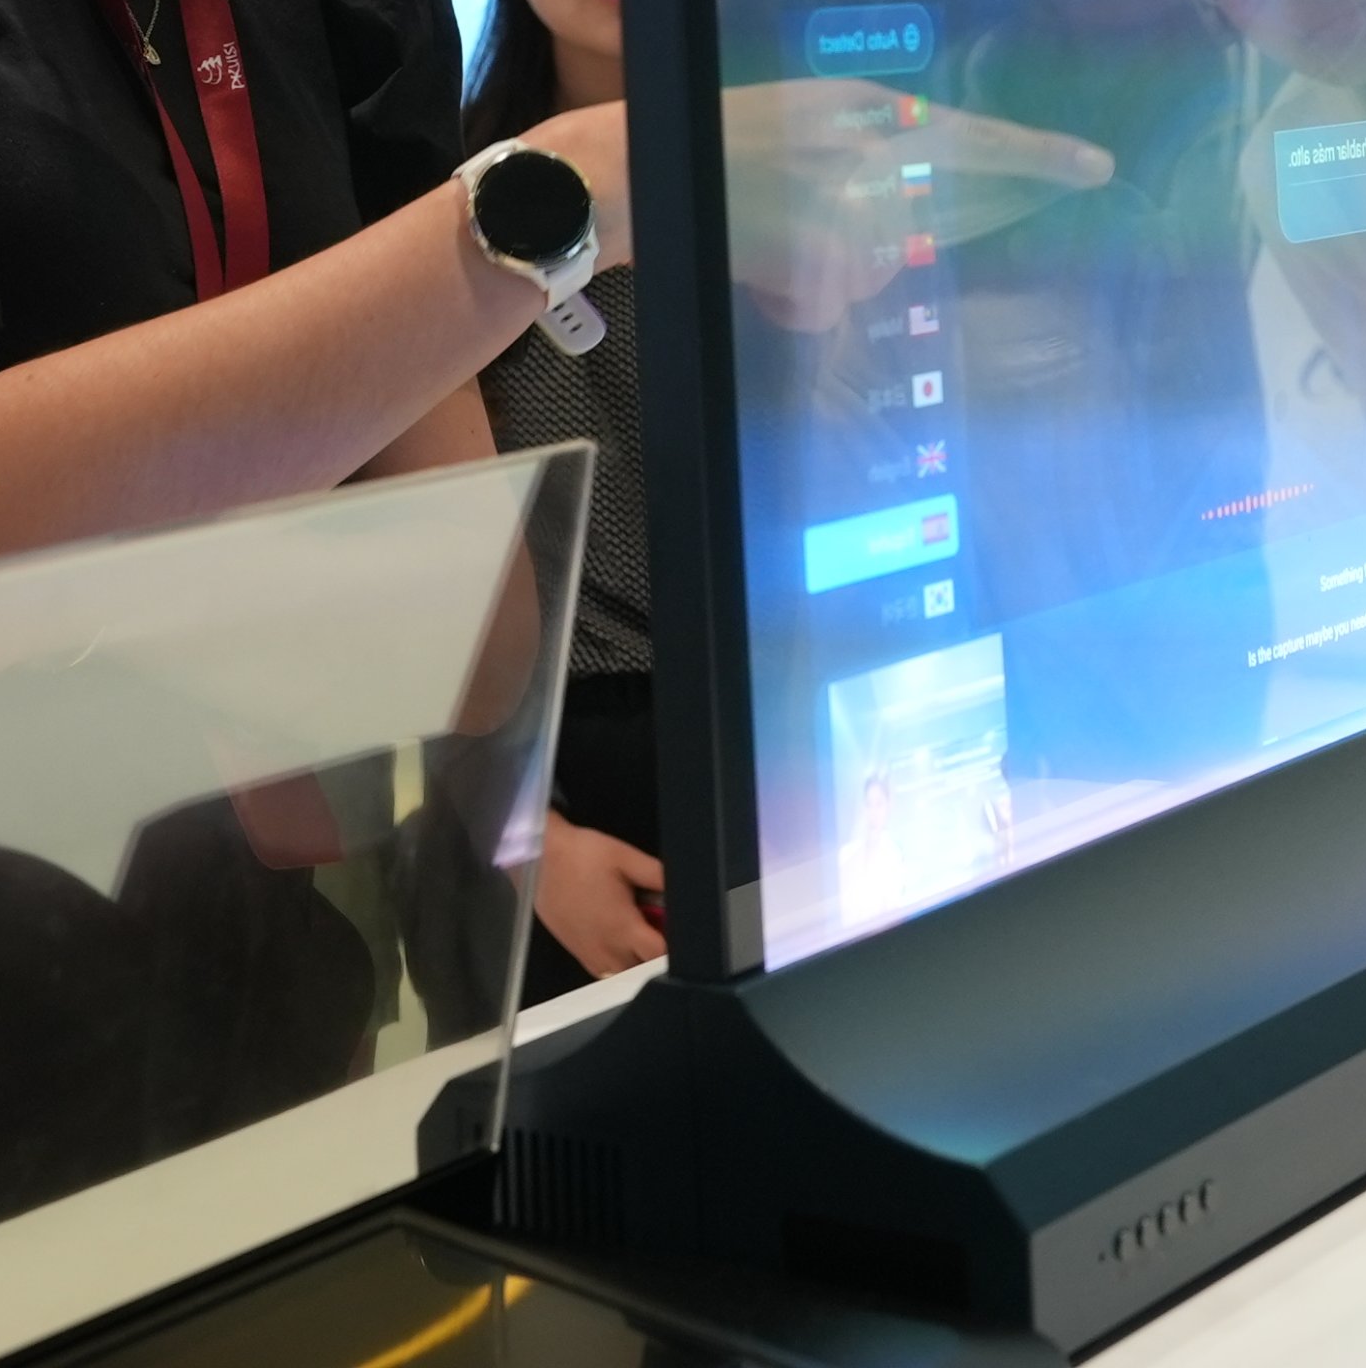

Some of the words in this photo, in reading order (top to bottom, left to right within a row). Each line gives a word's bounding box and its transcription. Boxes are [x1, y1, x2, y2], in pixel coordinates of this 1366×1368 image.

[1320, 566, 1364, 592] Something
[1248, 651, 1257, 668] Is
[1258, 645, 1272, 664] the
[1273, 636, 1305, 659] capture
[1305, 624, 1333, 648] maybe
[1334, 620, 1349, 642] you
